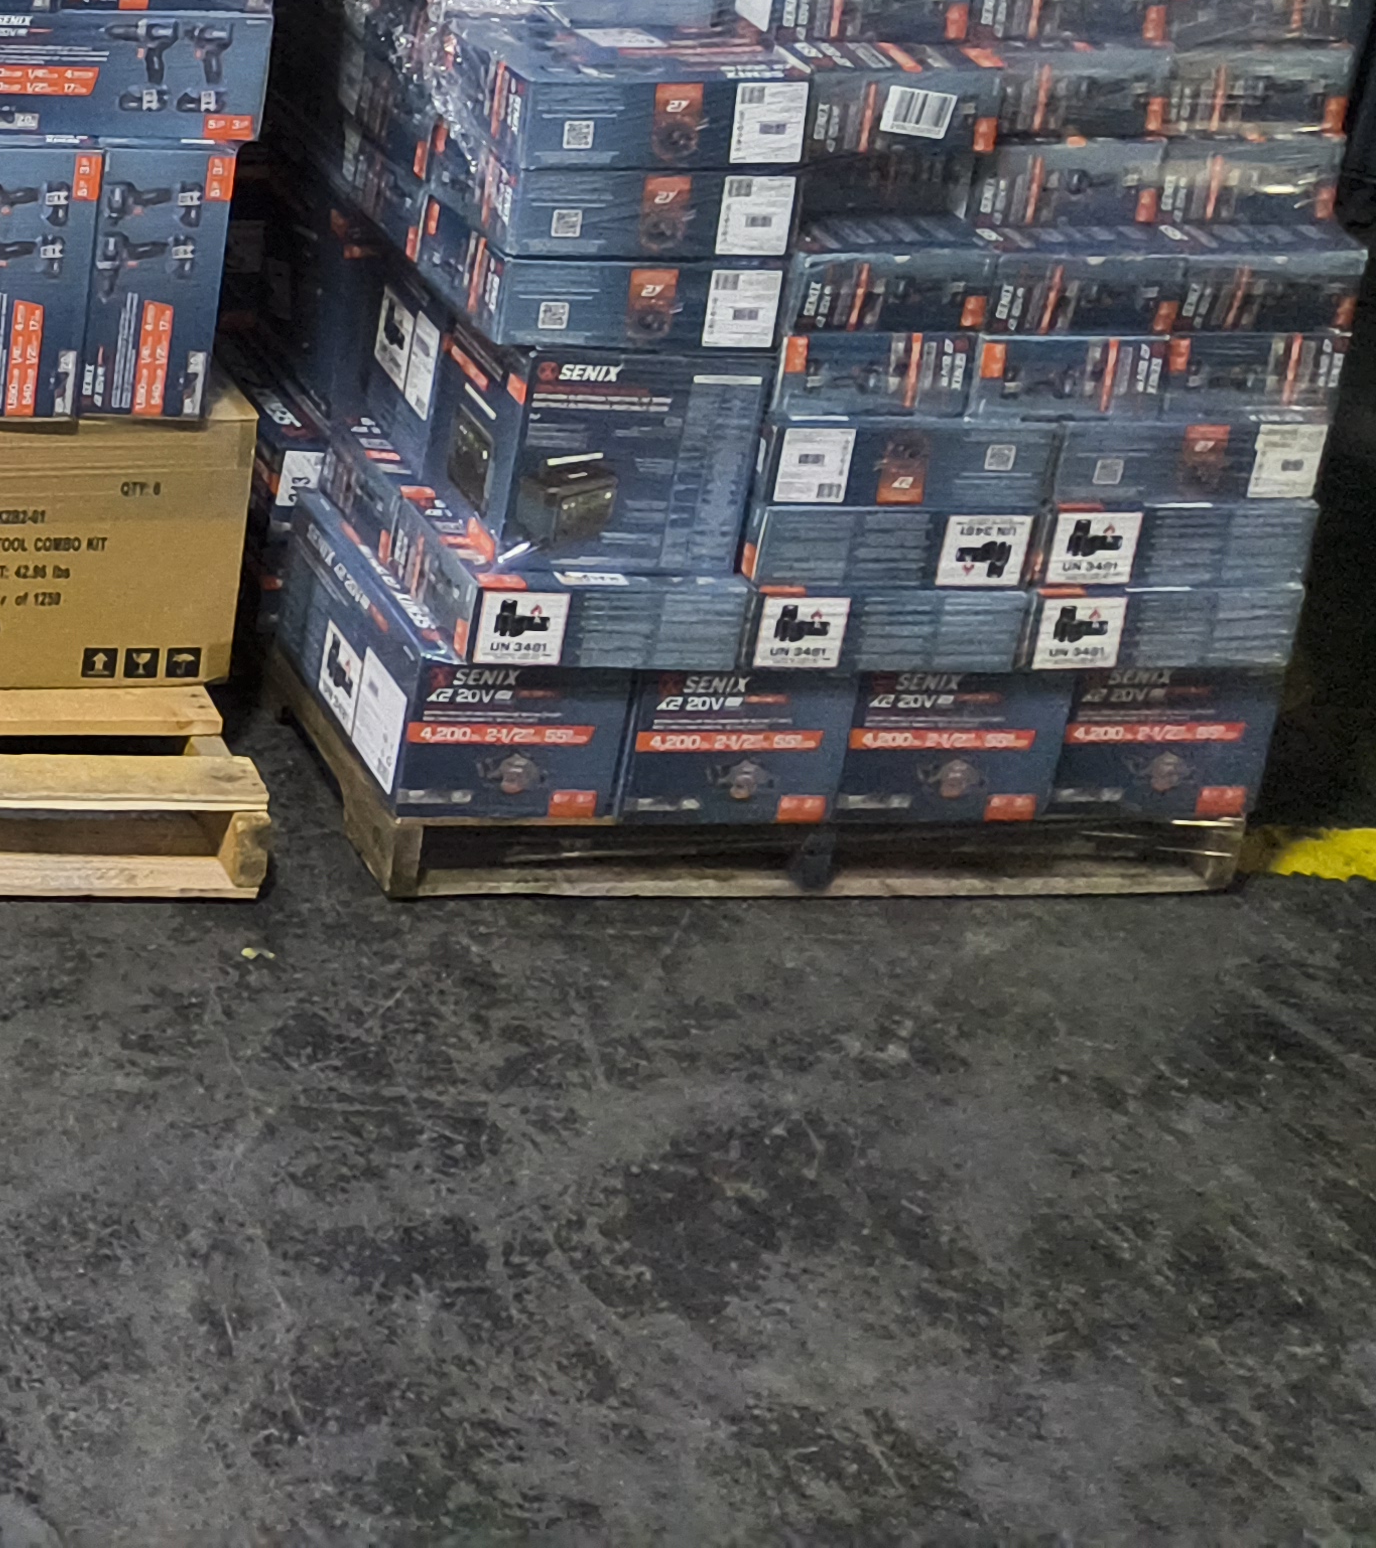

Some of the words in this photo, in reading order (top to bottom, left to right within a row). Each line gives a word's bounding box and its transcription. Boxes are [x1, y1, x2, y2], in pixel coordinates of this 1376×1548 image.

[558, 363, 622, 382] SENIX
[33, 537, 82, 552] COMBO
[86, 536, 108, 552] KIT
[52, 564, 71, 579] lbs
[15, 592, 29, 606] of
[33, 592, 62, 606] 1250
[490, 641, 510, 653] UN
[513, 640, 548, 653] 3481
[453, 668, 522, 687] SENIX
[682, 675, 751, 694] SENIX
[896, 672, 963, 691] SENIX
[455, 689, 495, 704] 20V
[685, 696, 725, 711] 20V
[897, 694, 936, 709] 20V
[420, 726, 471, 742] 4,200
[861, 732, 912, 748] 4,200
[649, 735, 701, 750] 4,200
